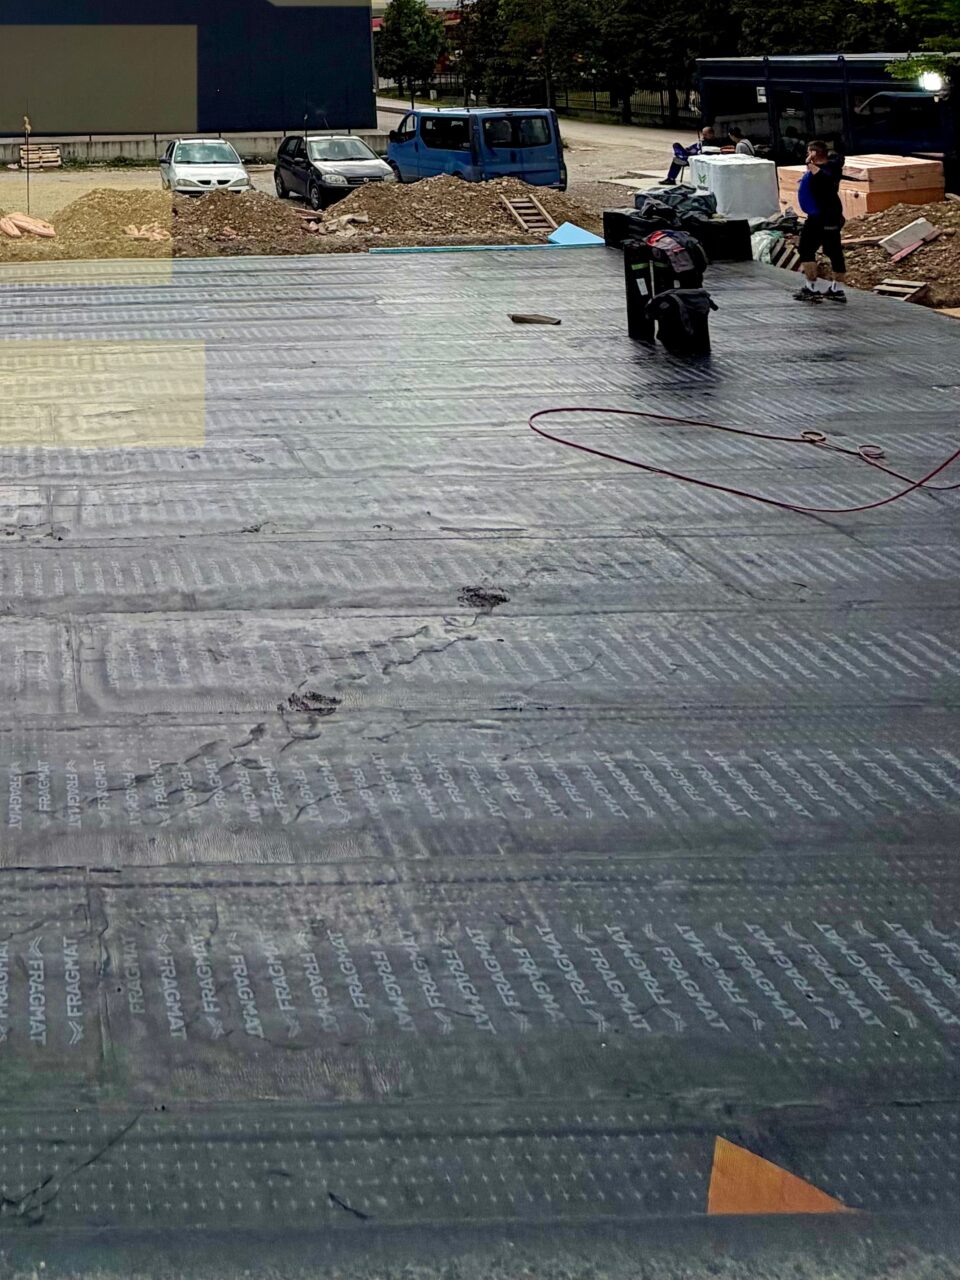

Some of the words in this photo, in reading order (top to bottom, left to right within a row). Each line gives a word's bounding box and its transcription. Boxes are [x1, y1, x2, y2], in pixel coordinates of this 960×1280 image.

[62, 936, 83, 1016] FRAGMAT
[121, 936, 145, 1013] FRAGMAT
[158, 956, 187, 1040] FRAGMAT
[192, 934, 220, 1013] FRAGMAT
[230, 955, 264, 1037] FRAGMAT
[259, 931, 294, 1010] FRAGMAT
[301, 953, 339, 1032] FRAGMAT
[327, 929, 370, 1009] FRAGMAT
[371, 951, 417, 1034] FRAGMAT
[397, 927, 445, 1008] FRAGMAT
[442, 948, 496, 1034] FRAGMAT
[466, 926, 520, 1008] FRAGMAT
[512, 948, 567, 1023] FRAGMA
[536, 924, 597, 1005] FRAGMAT
[585, 947, 651, 1032] FRAGMAT
[604, 923, 671, 1005] FRAGMAT
[655, 946, 730, 1032] FRAGMAT
[675, 922, 748, 1004] FRAGMAT
[729, 945, 808, 1030] FRAGMAT
[743, 920, 824, 1003] FRAGMAT
[799, 943, 886, 1028] FRAGMAT
[812, 920, 900, 1001] FRAGMAT
[882, 920, 960, 999] RAGMAT
[29, 961, 46, 1045] FRAGMAT
